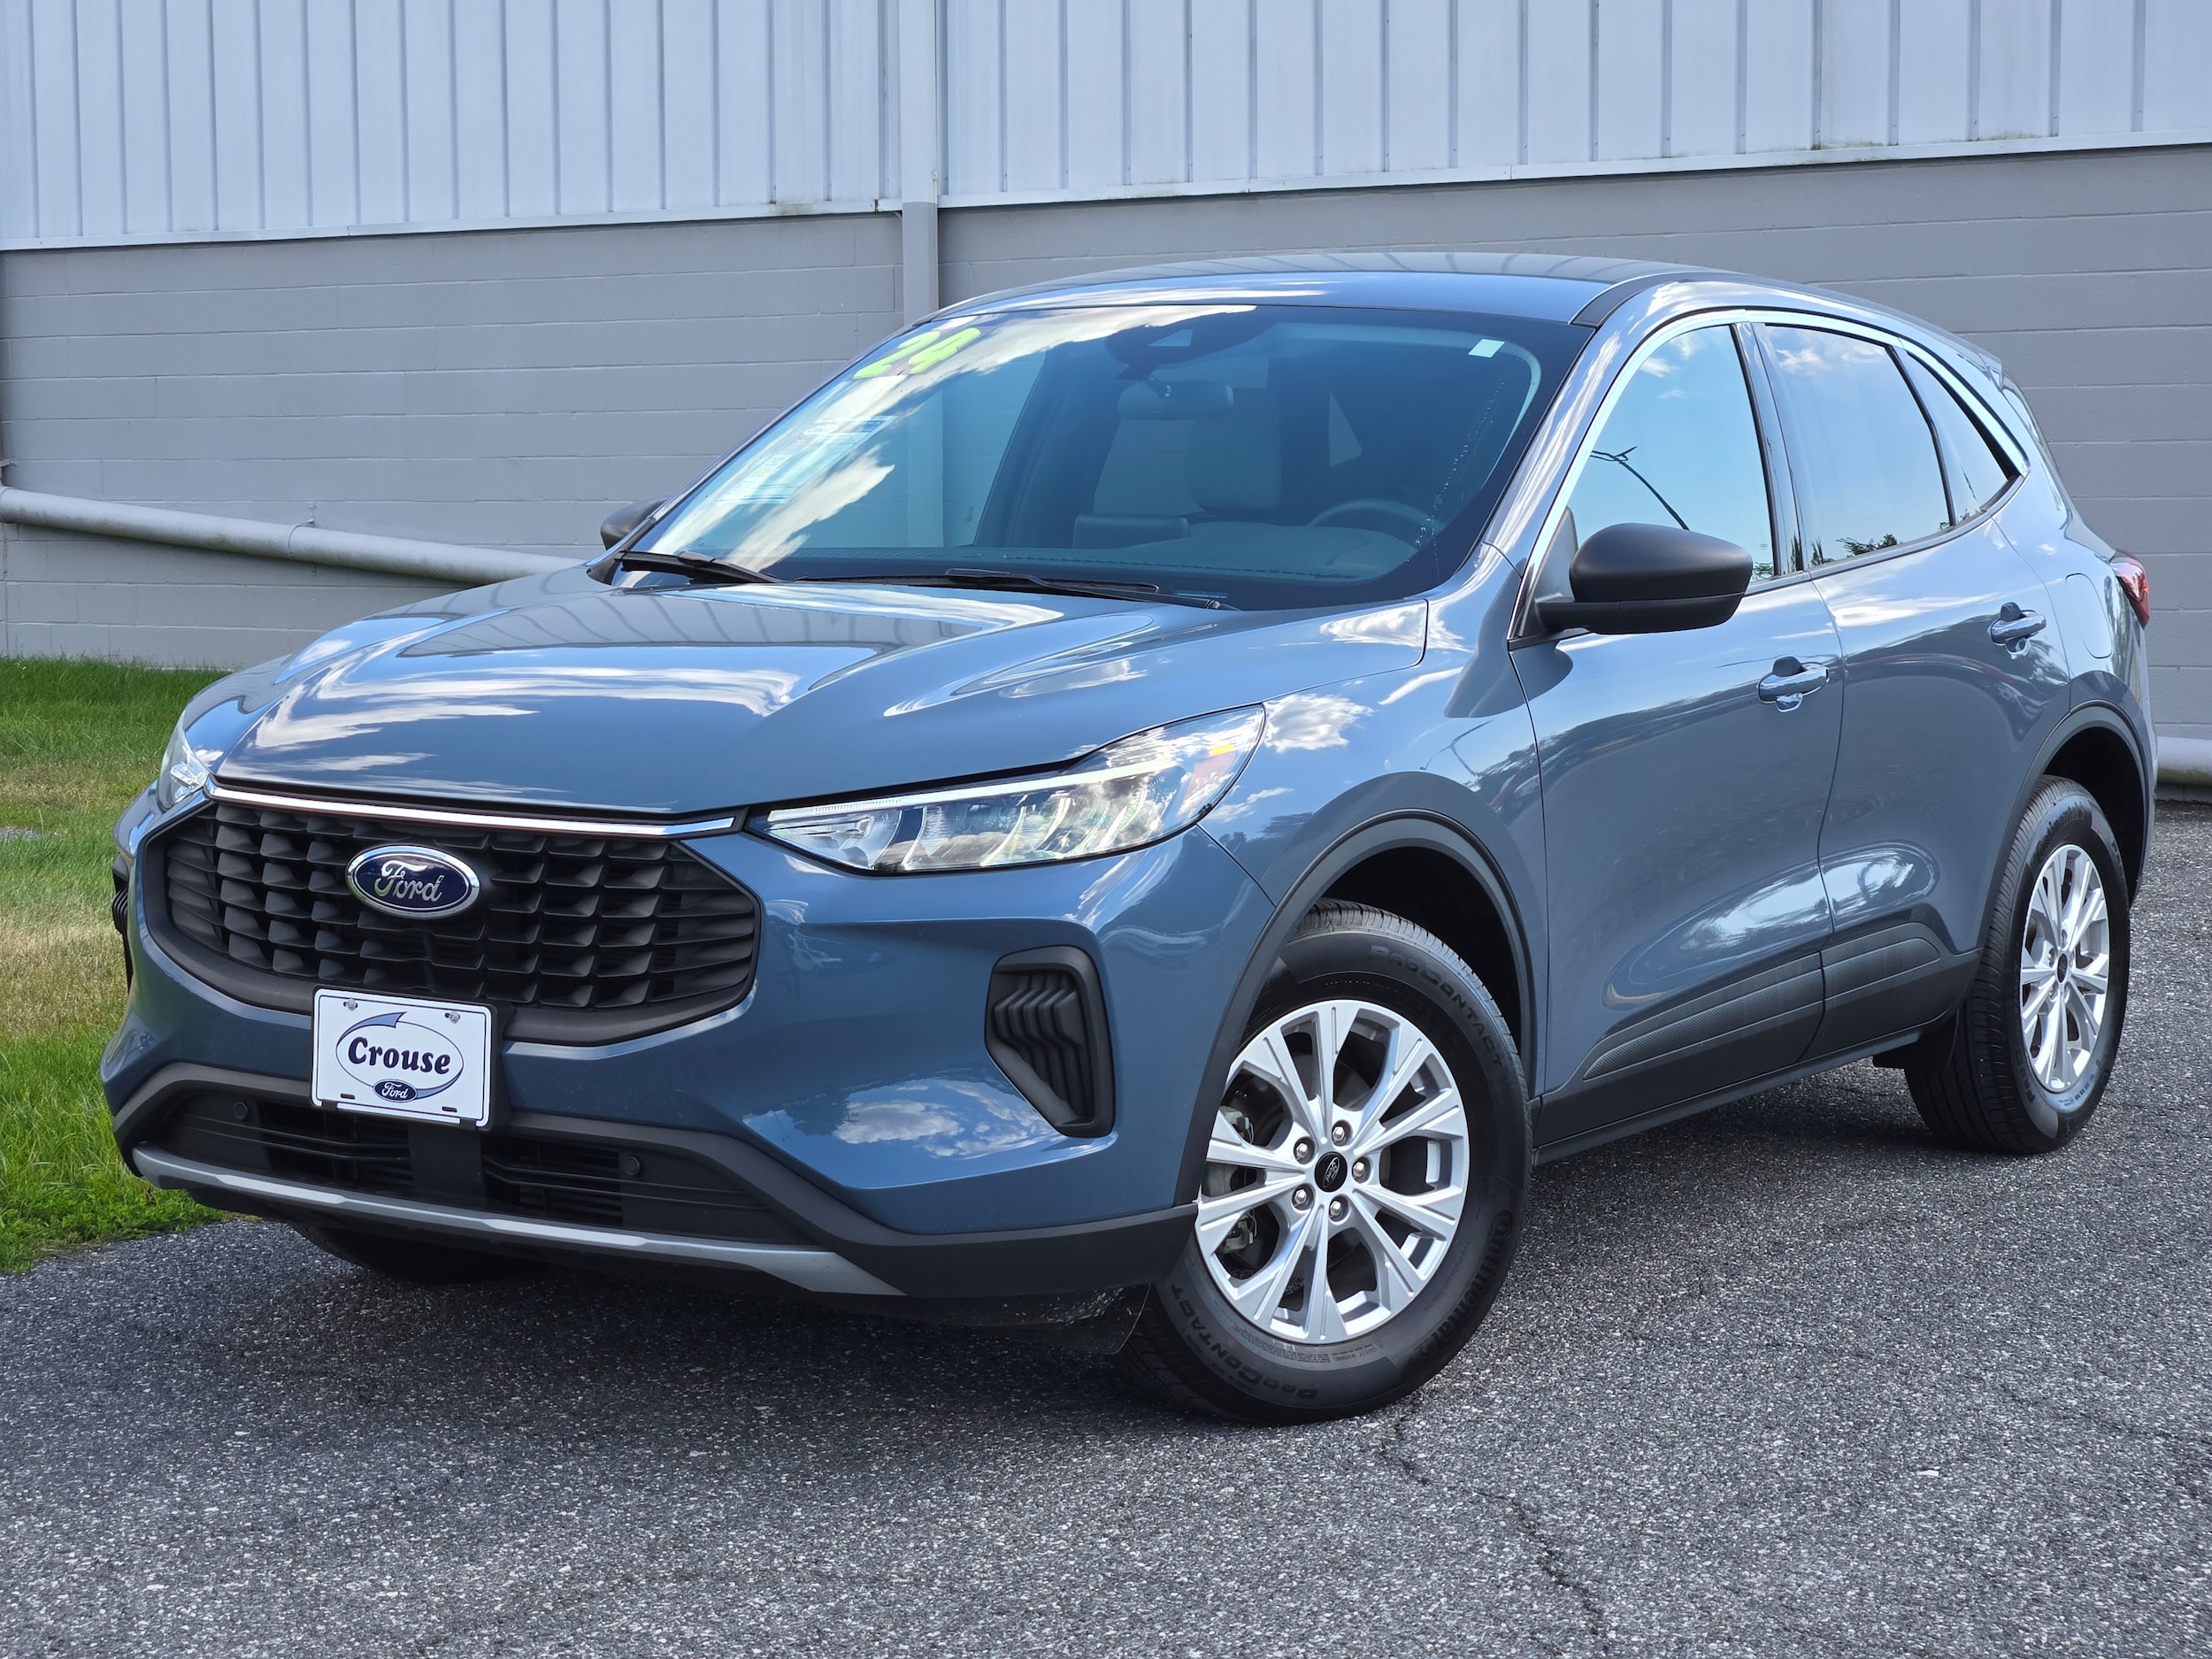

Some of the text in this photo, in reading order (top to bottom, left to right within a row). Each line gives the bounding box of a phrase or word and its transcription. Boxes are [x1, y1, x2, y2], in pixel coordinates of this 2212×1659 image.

[853, 327, 981, 379] 24
[374, 859, 445, 902] Ford
[347, 1036, 451, 1075] Crouse
[381, 1083, 410, 1100] Ford
